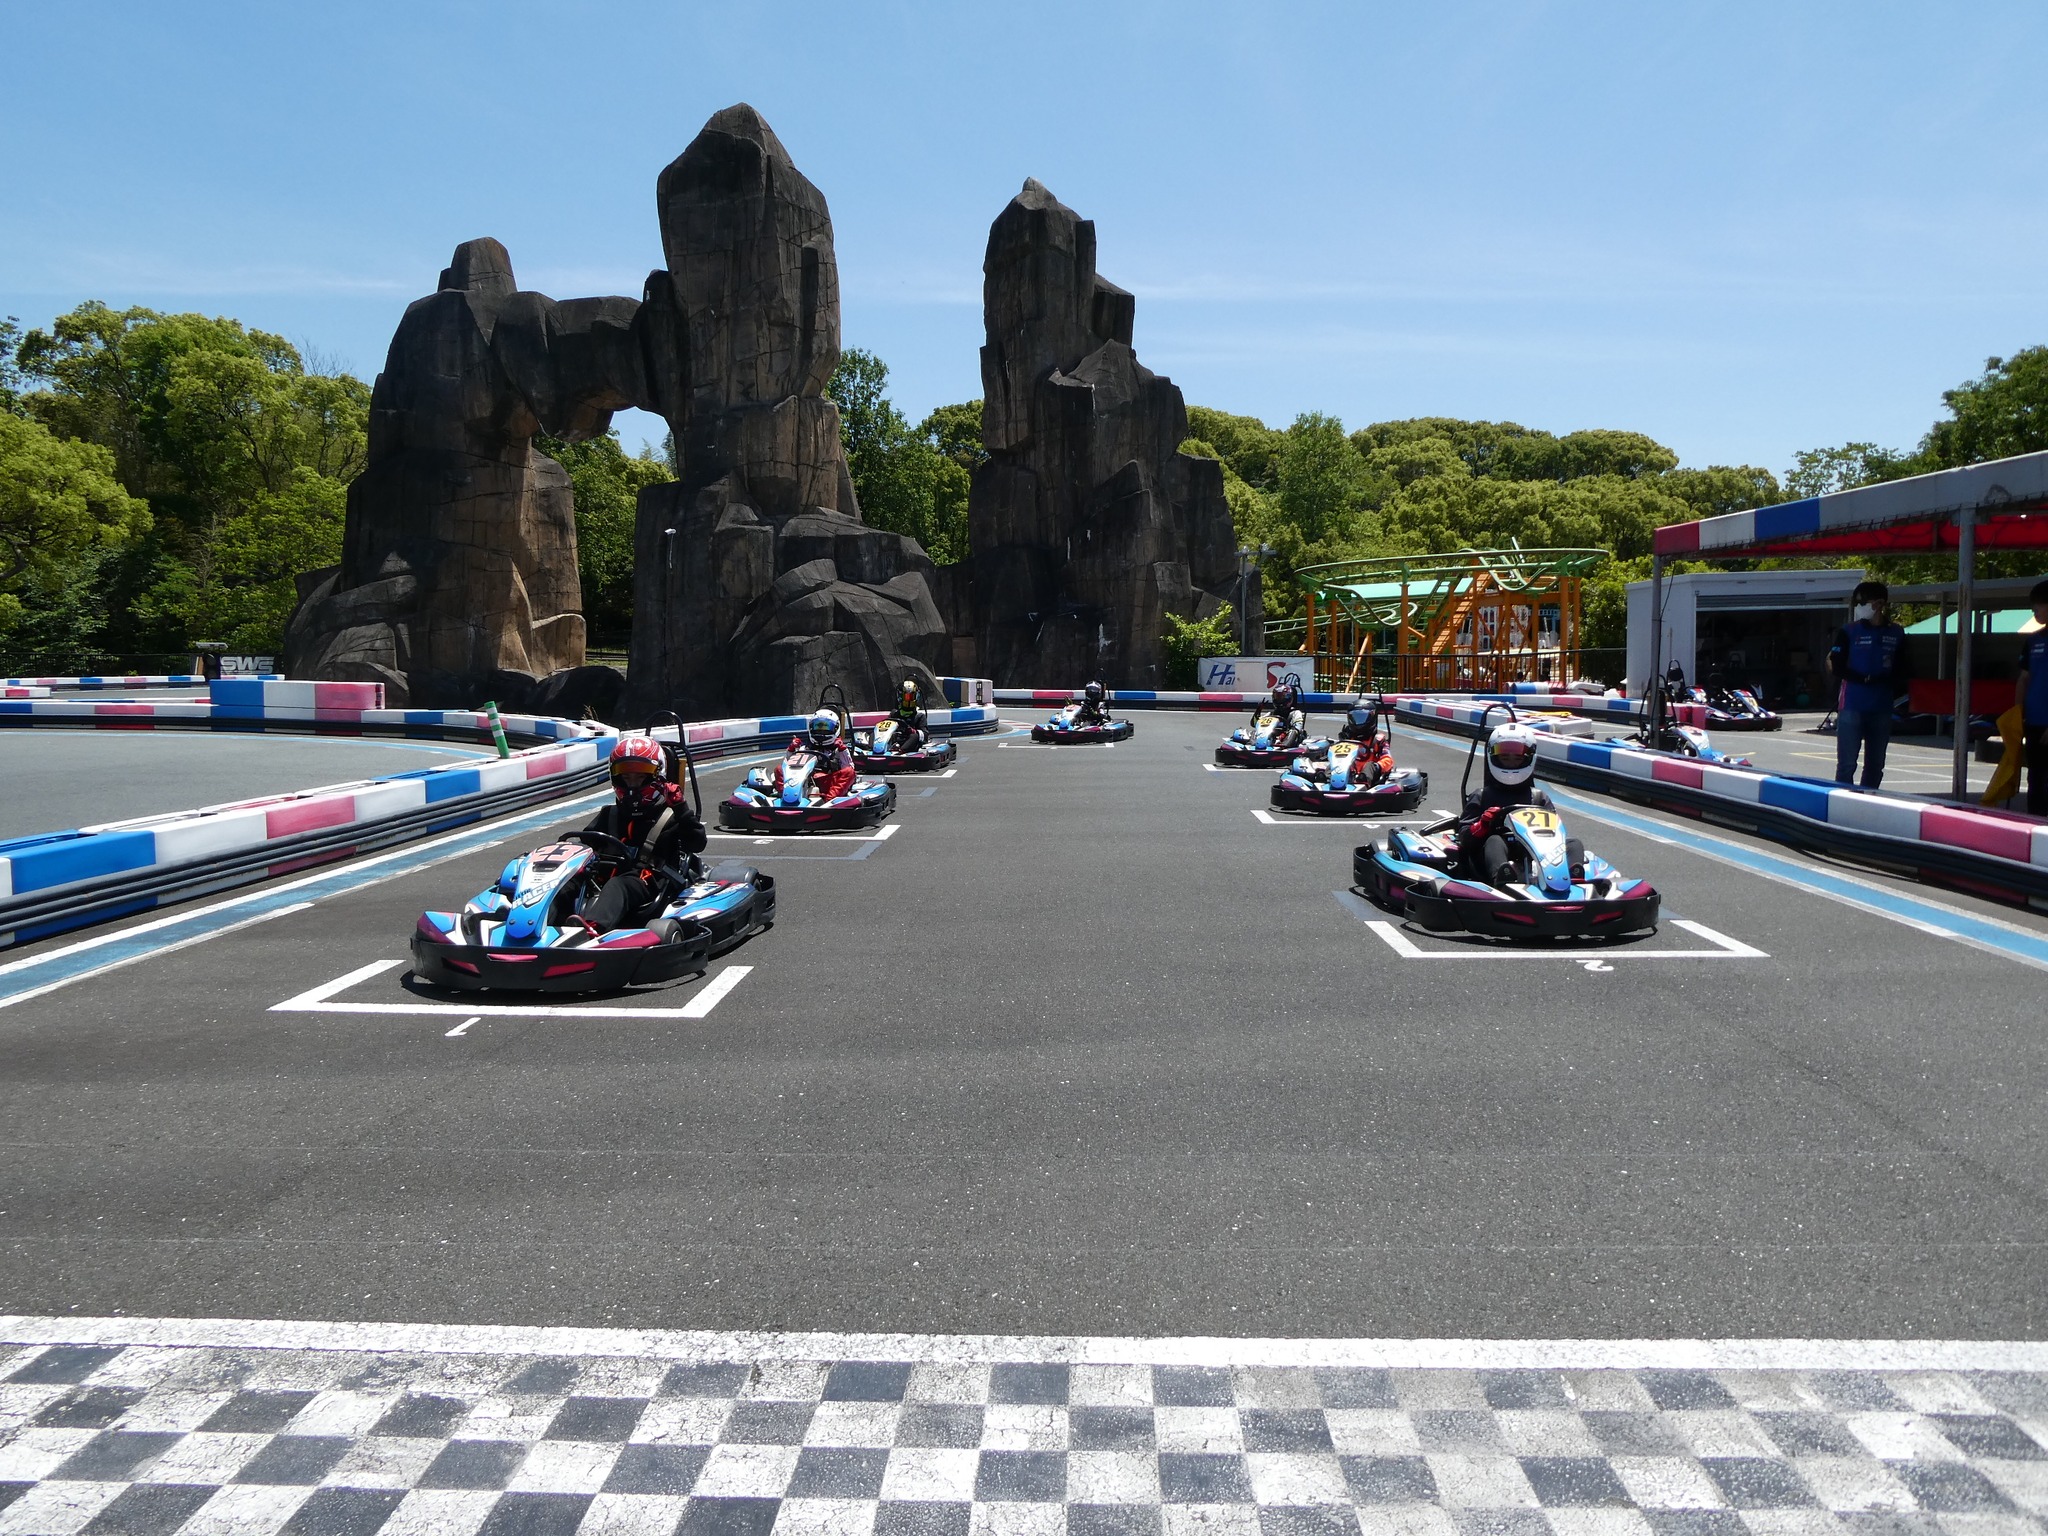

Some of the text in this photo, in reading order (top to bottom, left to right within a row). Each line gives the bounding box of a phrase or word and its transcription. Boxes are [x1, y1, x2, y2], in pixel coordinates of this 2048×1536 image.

[221, 656, 274, 675] SWS
[1206, 664, 1235, 685] Ha
[878, 721, 892, 729] 28
[1334, 744, 1351, 754] 25
[787, 752, 810, 765] 21
[1522, 811, 1550, 828] 27
[528, 844, 584, 862] 23
[1575, 959, 1615, 971] 2
